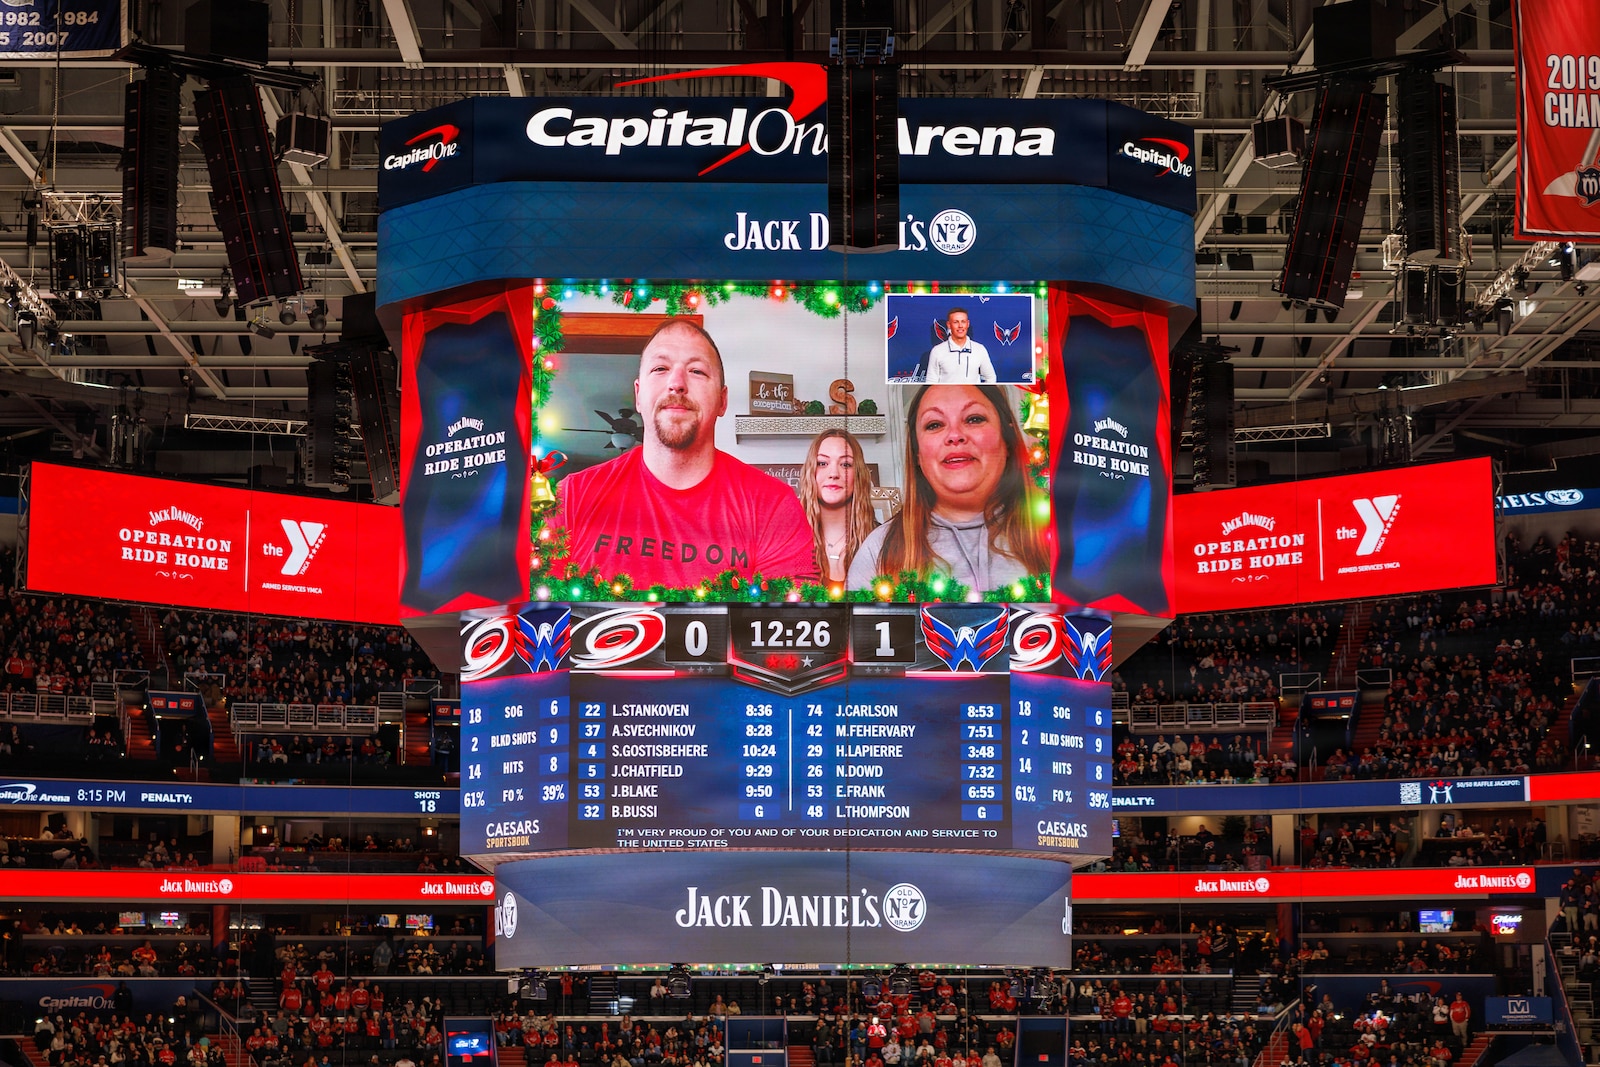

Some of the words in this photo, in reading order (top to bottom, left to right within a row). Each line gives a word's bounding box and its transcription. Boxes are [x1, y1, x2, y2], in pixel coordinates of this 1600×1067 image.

[53, 11, 98, 25] 1984
[22, 32, 69, 46] 2007
[724, 212, 802, 250] JACK
[941, 243, 966, 251] BRAND
[756, 383, 770, 399] be
[771, 384, 789, 401] the
[753, 400, 792, 411] exception
[447, 420, 462, 437] JACK
[1094, 419, 1107, 433] JACK
[426, 431, 506, 457] OPERATION
[1074, 433, 1148, 458] OPERATION
[424, 458, 459, 476] RIDE
[464, 449, 506, 468] HOME
[1073, 451, 1106, 468] RIDE
[1110, 458, 1149, 476] HOME
[149, 508, 171, 526] JACK
[171, 506, 204, 532] DANIEL'S
[1221, 516, 1243, 536] JACK
[1242, 512, 1275, 532] DANIEL'S
[119, 528, 231, 552] OPERATION
[1336, 526, 1357, 540] the
[263, 543, 283, 556] the
[593, 533, 748, 568] FREEDOM
[1194, 534, 1304, 556] OPERATION
[121, 547, 167, 564] RIDE
[175, 553, 228, 570] HOME
[1197, 558, 1242, 573] RIDE
[1249, 552, 1303, 568] HOME
[1358, 564, 1383, 572] SERVICES
[282, 584, 306, 592] SERVICES
[685, 620, 708, 657] 0
[750, 620, 831, 647] 12:26
[875, 621, 895, 657] 1
[469, 708, 481, 723] 18
[505, 705, 523, 718] SOG
[550, 700, 558, 715] 6
[584, 704, 600, 717] 22
[612, 704, 688, 717] L.STANKOVEN
[745, 704, 773, 717] 8:36
[807, 704, 822, 718] 74
[836, 704, 898, 718] J.CARLSON
[967, 705, 994, 718] 8:53
[1019, 700, 1031, 716] 18
[1053, 706, 1071, 720] SOG
[1095, 710, 1102, 726] 6
[584, 724, 600, 737] 37
[612, 724, 695, 737] A.SVECHNIKOV
[745, 724, 773, 737] 8:28
[807, 725, 822, 738] 42
[836, 725, 915, 738] M.FEHERVARY
[967, 726, 994, 738] 7:51
[471, 737, 478, 752] 2
[491, 734, 511, 747] BLKD
[512, 731, 536, 745] SHOTS
[550, 728, 558, 743] 9
[1021, 729, 1029, 745] 2
[1040, 732, 1060, 746] BLKD
[1060, 734, 1083, 748] SHOTS
[1095, 738, 1102, 753] 9
[588, 745, 597, 757] 4
[612, 745, 708, 757] S.GOSTISBEHERE
[742, 745, 776, 757] 10:24
[807, 746, 822, 758] 29
[836, 746, 902, 758] H.LAPIERRE
[967, 746, 994, 758] 3:48
[469, 764, 481, 779] 14
[503, 761, 524, 774] HITS
[550, 757, 558, 772] 8
[588, 765, 597, 777] 5
[612, 765, 682, 777] J.CHATFIELD
[745, 765, 773, 777] 9:29
[807, 766, 822, 778] 26
[836, 766, 883, 778] N.DOWD
[967, 766, 994, 778] 7:32
[1019, 758, 1032, 773] 14
[1052, 762, 1072, 775] HITS
[1095, 765, 1103, 780] 8
[39, 793, 71, 802] Arena
[77, 789, 102, 801] 8:15
[106, 790, 126, 802] PM
[141, 793, 192, 803] PENALTY:
[414, 791, 440, 799] SHOTS
[464, 791, 485, 807] 61%
[503, 790, 515, 802] FO
[516, 788, 523, 801] %
[542, 784, 565, 801] 39%
[584, 786, 600, 798] 53
[612, 786, 658, 798] J.BLAKE
[745, 786, 773, 798] 9:50
[807, 786, 822, 798] 53
[836, 786, 885, 798] E.FRANK
[967, 786, 994, 799] 6:55
[1015, 785, 1036, 801] 61%
[1053, 789, 1064, 802] FO
[1065, 790, 1072, 803] %
[1089, 792, 1109, 808] 39%
[420, 800, 436, 812] 18
[584, 806, 600, 818] 32
[612, 806, 657, 818] B.BUSSI
[754, 806, 764, 818] G
[807, 806, 822, 818] 48
[836, 806, 910, 818] L.THOMPSON
[977, 807, 987, 820] G
[486, 820, 540, 837] CAESARS
[617, 829, 634, 837] I'M
[638, 829, 665, 837] VERY
[669, 829, 707, 837] PROUD
[710, 829, 725, 837] OF
[728, 829, 751, 837] YOU
[754, 829, 778, 837] AND
[781, 829, 796, 837] OF
[800, 829, 830, 837] YOUR
[833, 829, 902, 837] DEDICATION
[905, 829, 928, 837] AND
[932, 829, 979, 837] SERVICE
[982, 829, 998, 837] TO
[1038, 820, 1088, 838] CAESARS
[486, 836, 530, 848] SPORTSBOOK
[617, 839, 639, 847] THE
[642, 839, 684, 847] UNITED
[687, 839, 728, 847] STATES
[1038, 836, 1079, 848] SPORTSBOOK
[160, 879, 182, 893] JACK
[184, 879, 219, 893] DANIEL'S
[421, 881, 444, 894] JACK
[445, 881, 480, 894] DANIEL'S
[1195, 879, 1218, 892] JACK
[1220, 879, 1255, 892] DANIEL'S
[1454, 875, 1478, 888] JACK
[1479, 875, 1516, 887] DANIEL'S
[897, 889, 912, 897] OLD
[675, 887, 752, 927] JACK
[761, 887, 880, 927] DANIEL'S
